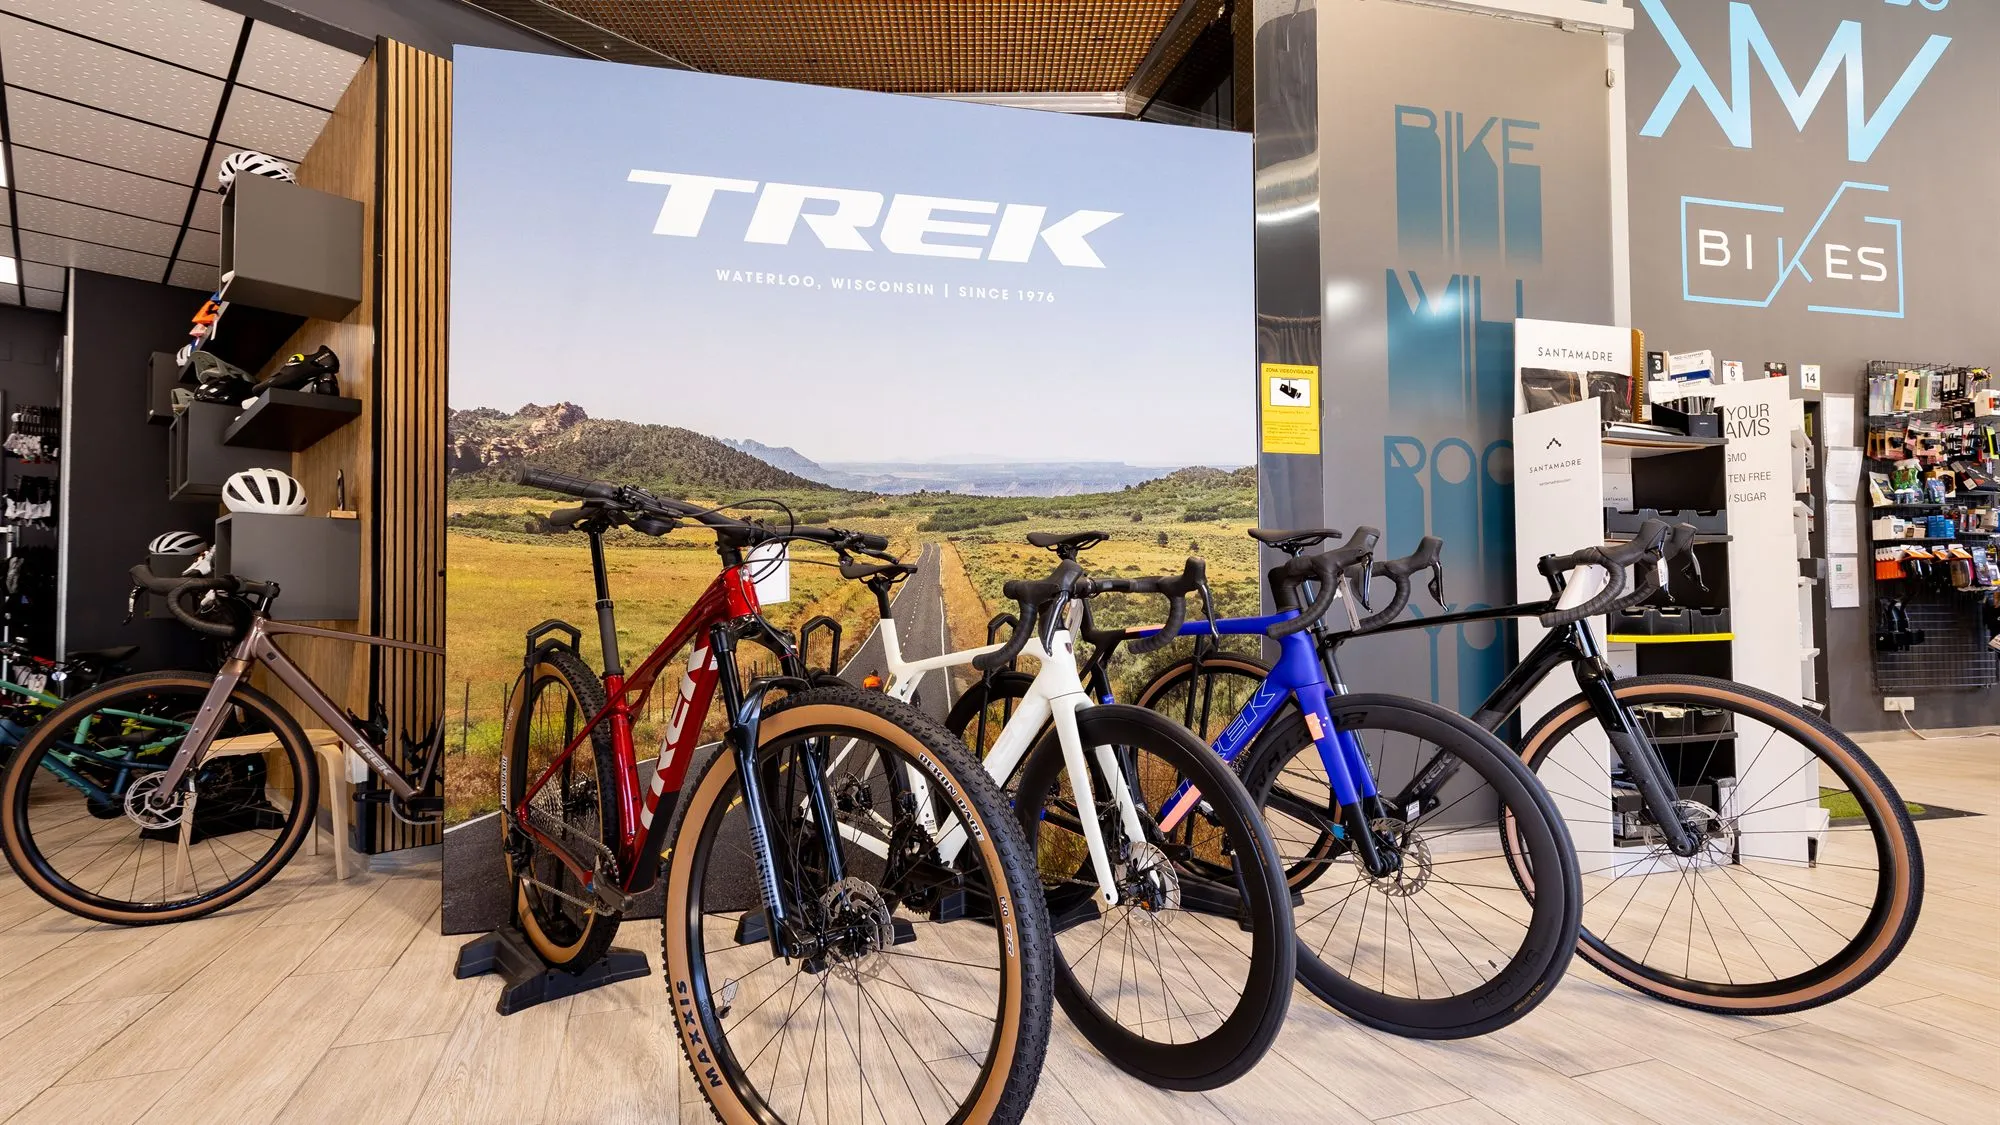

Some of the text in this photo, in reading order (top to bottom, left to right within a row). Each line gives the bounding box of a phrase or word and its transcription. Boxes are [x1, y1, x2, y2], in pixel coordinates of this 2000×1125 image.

[1395, 104, 1542, 230] BIKE
[627, 169, 1124, 269] TREK
[1699, 228, 1888, 284] BIKES
[716, 268, 1056, 304] WATERLOO, WISCONSIN SINCE 1976
[1537, 346, 1613, 362] SANTAMADRE
[1655, 360, 1662, 370] 3
[1730, 366, 1736, 378] 6
[1805, 372, 1817, 383] 14
[1726, 403, 1770, 421] YOUR
[1529, 458, 1582, 474] SANTAMADRE
[1748, 471, 1772, 482] FREE
[1733, 491, 1767, 503] SUGAR
[355, 739, 394, 777] TREK
[1411, 752, 1452, 796] TREK
[676, 980, 723, 1088] MAXXIS
